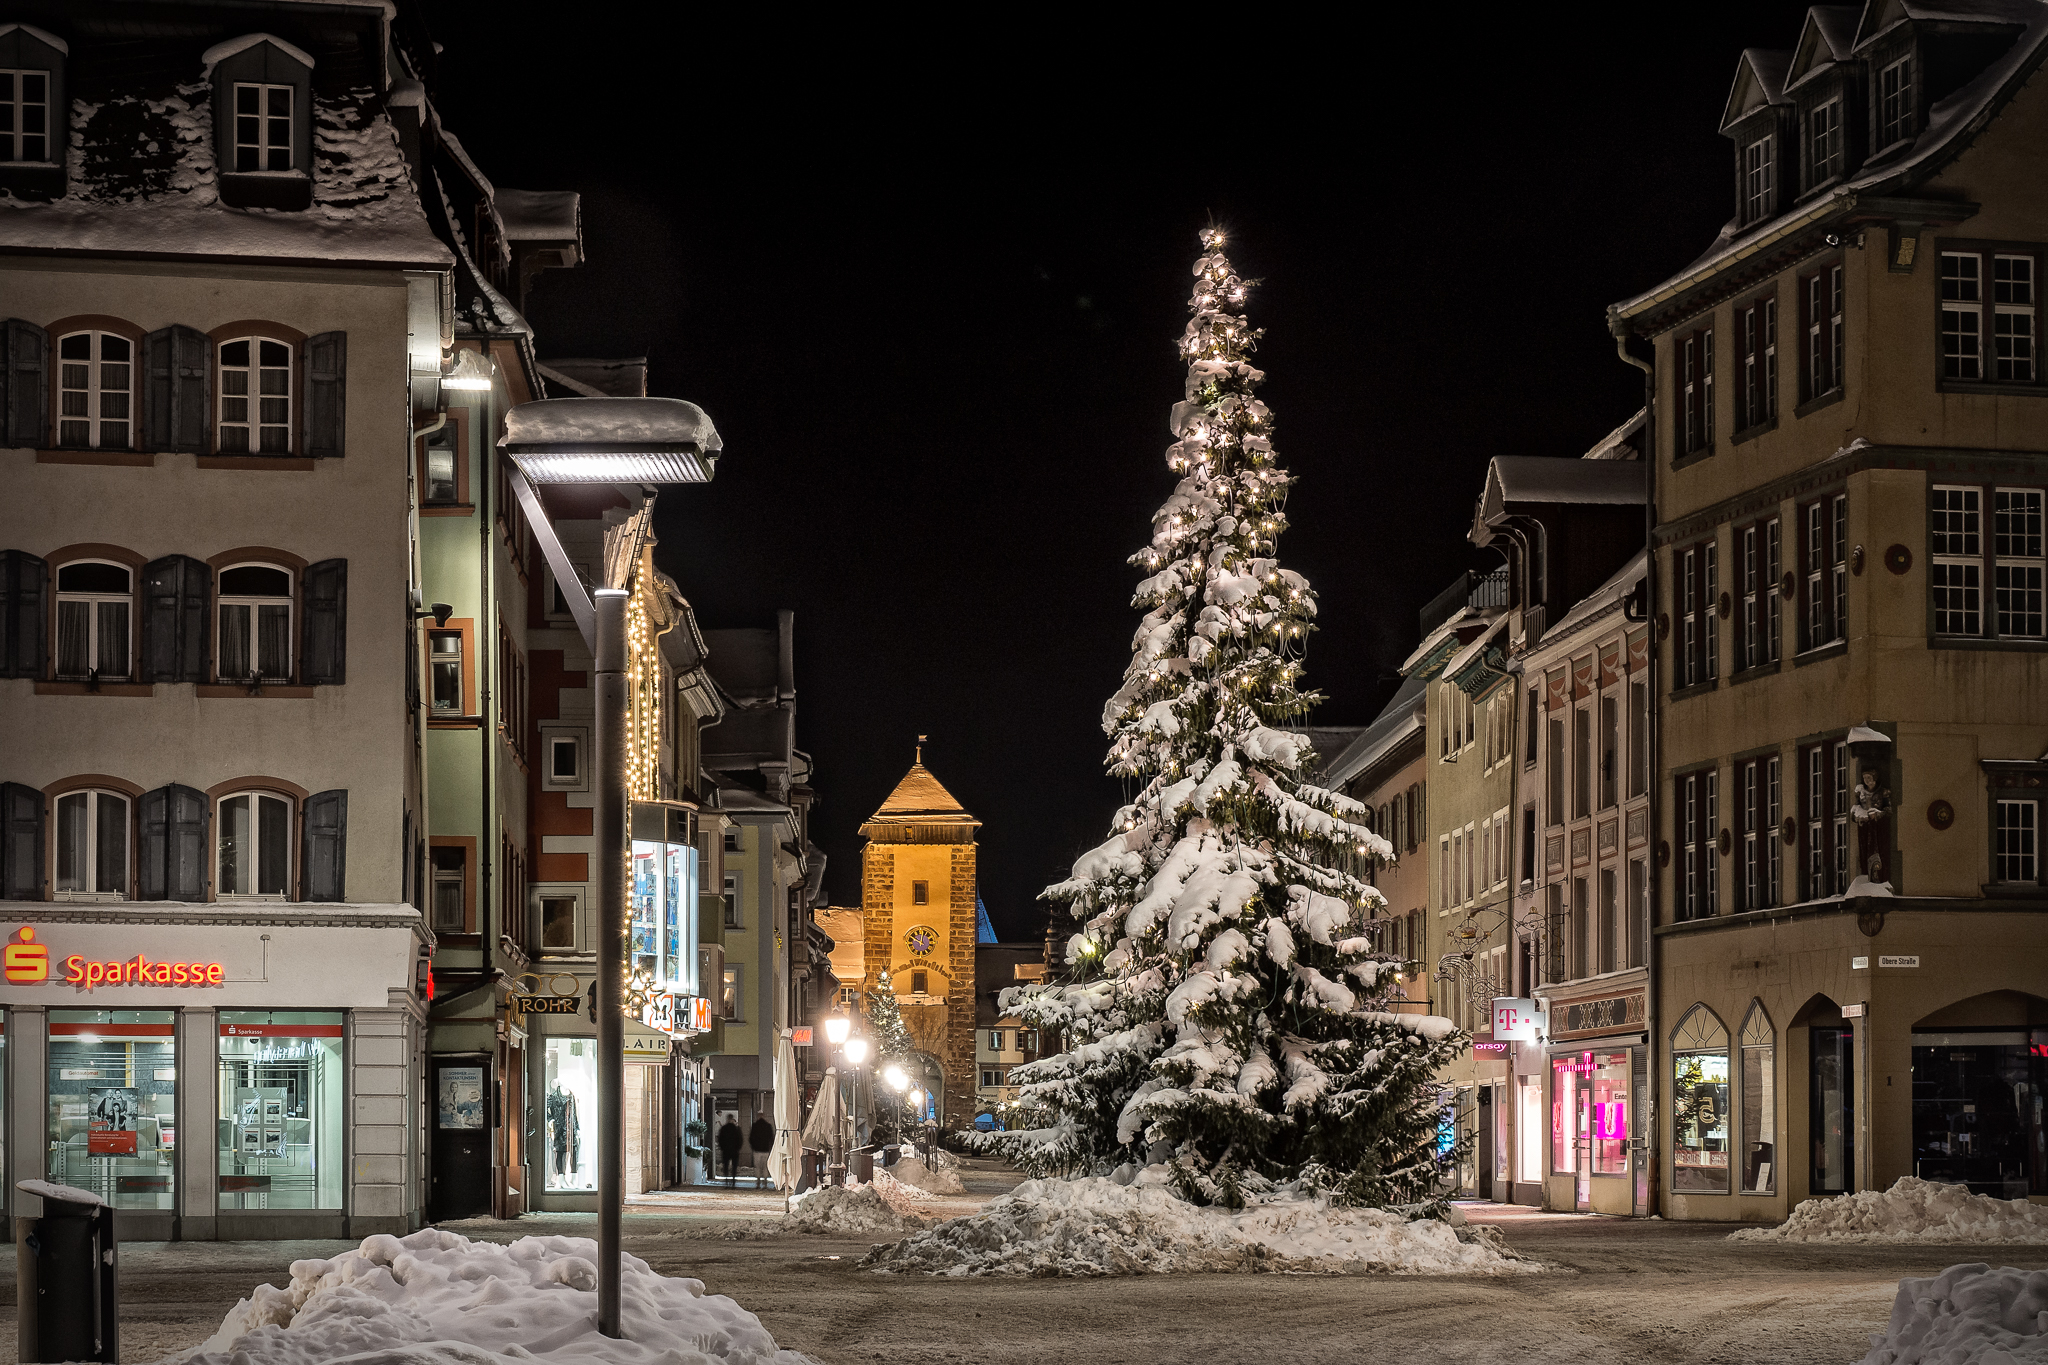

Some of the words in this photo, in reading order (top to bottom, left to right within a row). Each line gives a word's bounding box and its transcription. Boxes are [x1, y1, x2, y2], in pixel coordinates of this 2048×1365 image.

[1881, 957, 1898, 965] Obere
[1898, 957, 1916, 965] Straße
[66, 954, 223, 989] Sparkasse
[521, 998, 576, 1012] ROHR
[1498, 1008, 1518, 1031] T
[1475, 1043, 1507, 1052] orsay
[1886, 1076, 1892, 1086] 1
